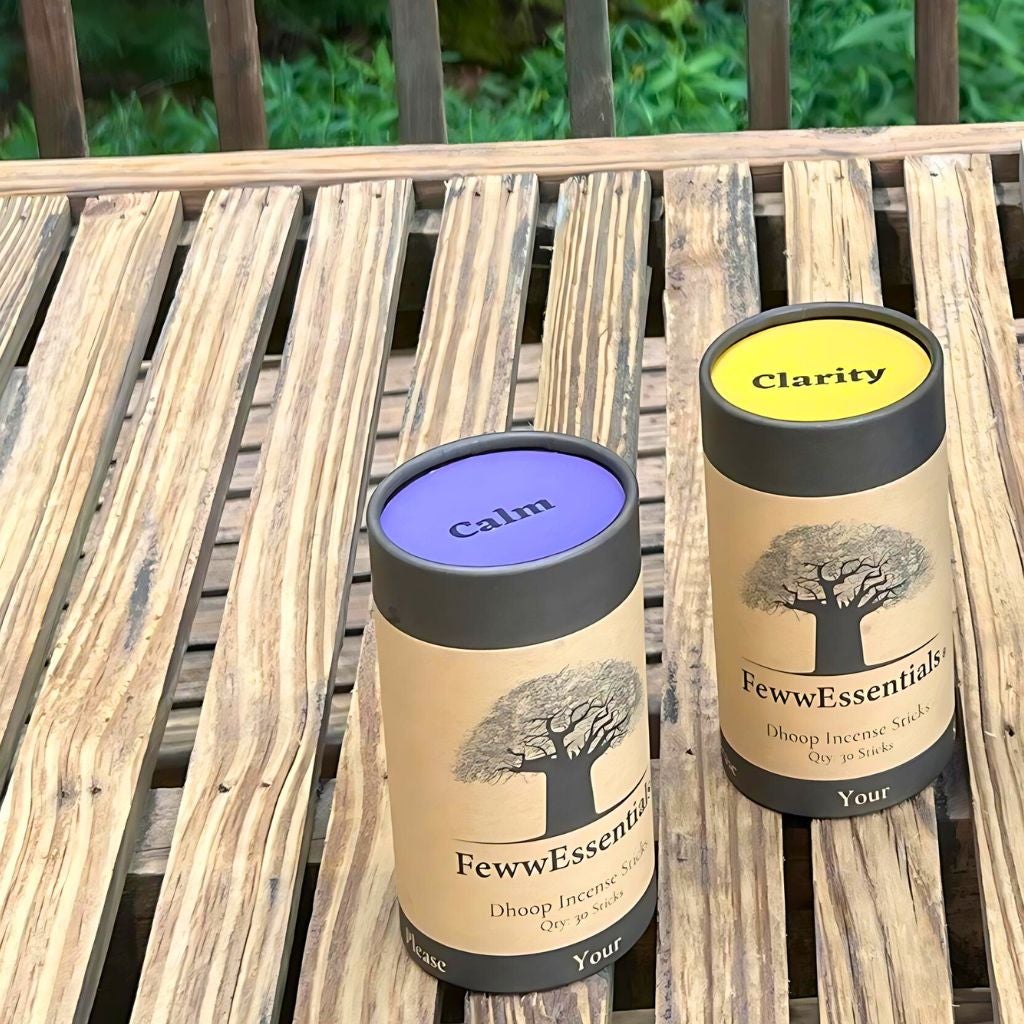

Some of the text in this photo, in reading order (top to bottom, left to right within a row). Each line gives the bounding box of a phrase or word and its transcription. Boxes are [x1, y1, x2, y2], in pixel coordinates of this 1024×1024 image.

[752, 367, 887, 389] Clarity
[449, 499, 556, 538] Calm
[741, 649, 941, 709] FewwEssentials
[766, 723, 820, 749] Dhoop
[826, 725, 887, 745] Incense
[892, 703, 931, 732] Sticks
[840, 753, 855, 764] 30
[858, 741, 894, 760] Sticks
[837, 786, 891, 807] Your
[490, 840, 649, 919] Dhoop Incense Sticks
[574, 911, 589, 926] 30
[592, 890, 624, 915] Sticks
[405, 927, 623, 973] Please Your
